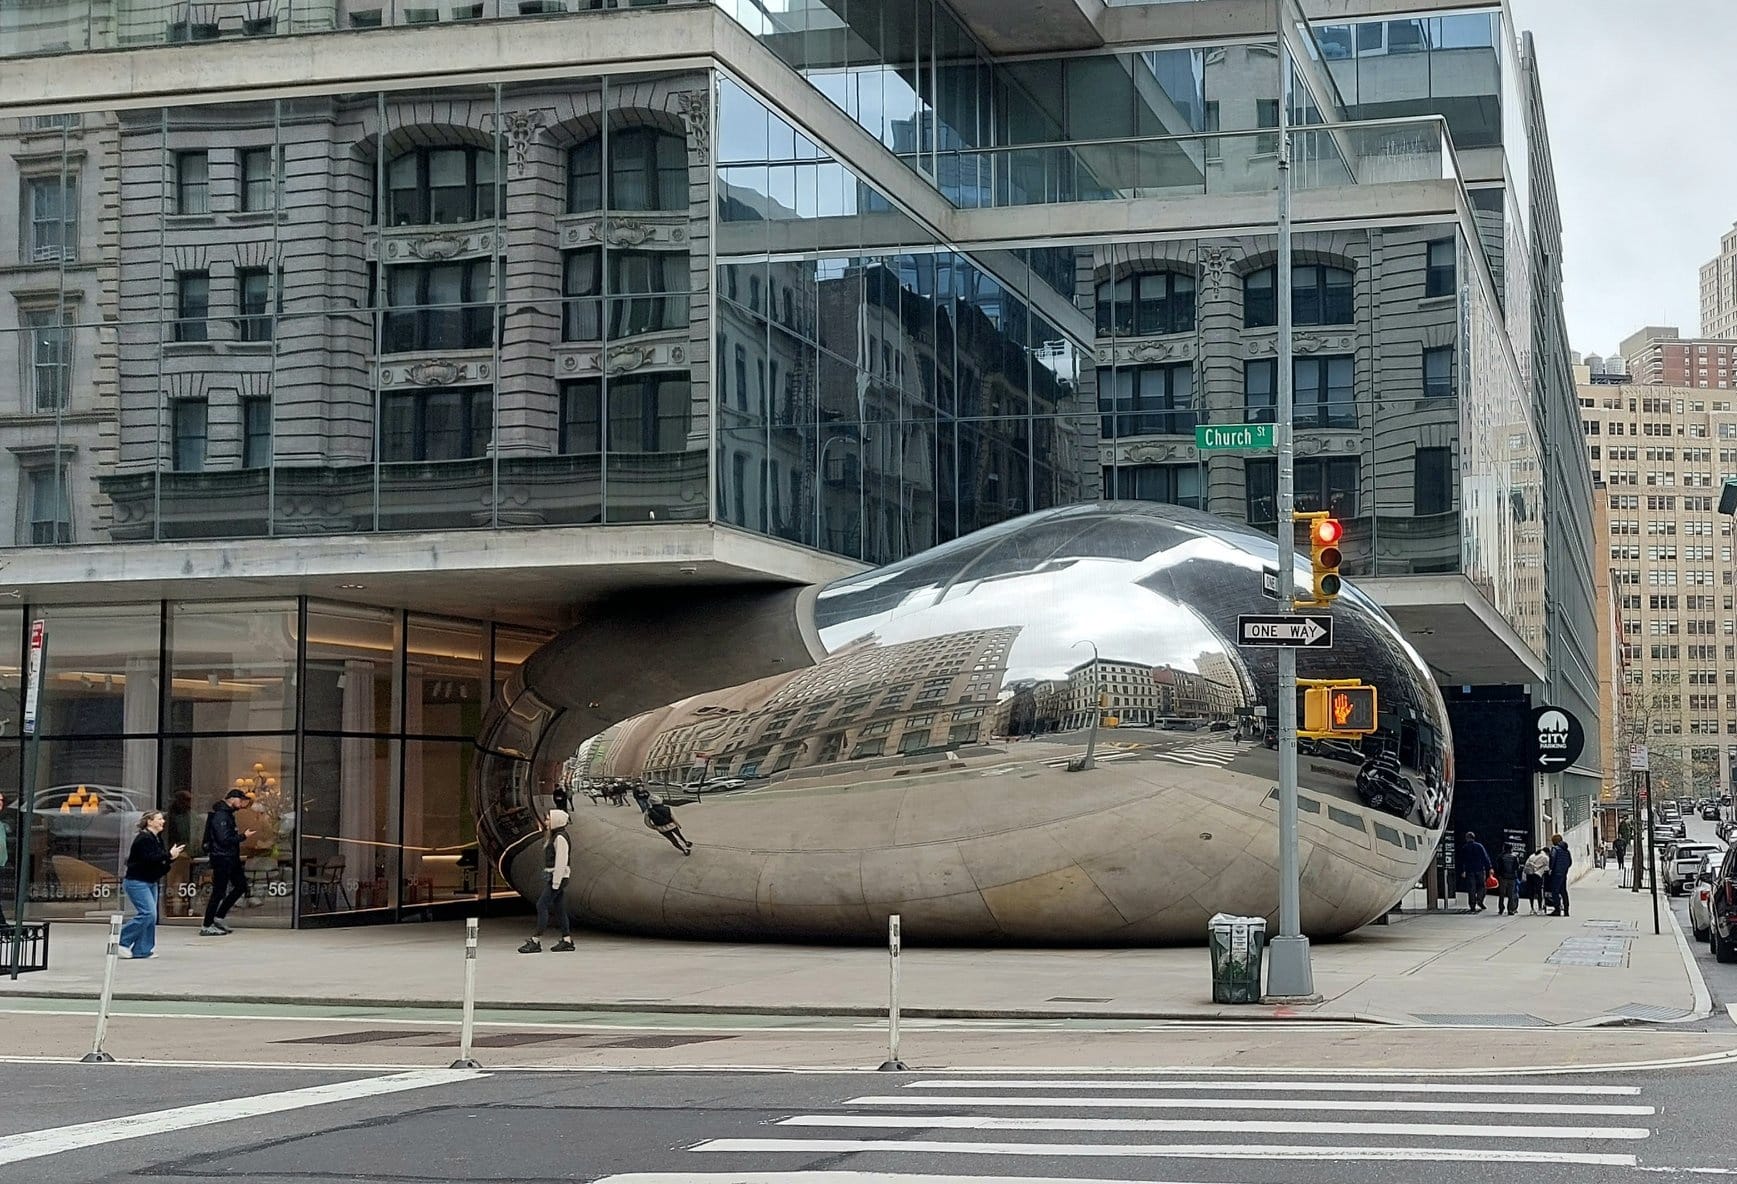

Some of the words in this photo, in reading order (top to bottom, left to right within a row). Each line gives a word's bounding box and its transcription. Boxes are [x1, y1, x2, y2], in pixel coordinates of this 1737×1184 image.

[1205, 428, 1252, 446] Church
[1257, 426, 1266, 437] St
[1252, 625, 1278, 637] ONE
[1290, 625, 1318, 638] WAY
[1538, 733, 1569, 743] CITY
[93, 883, 111, 898] 56
[178, 882, 197, 897] 56
[268, 881, 287, 896] 56
